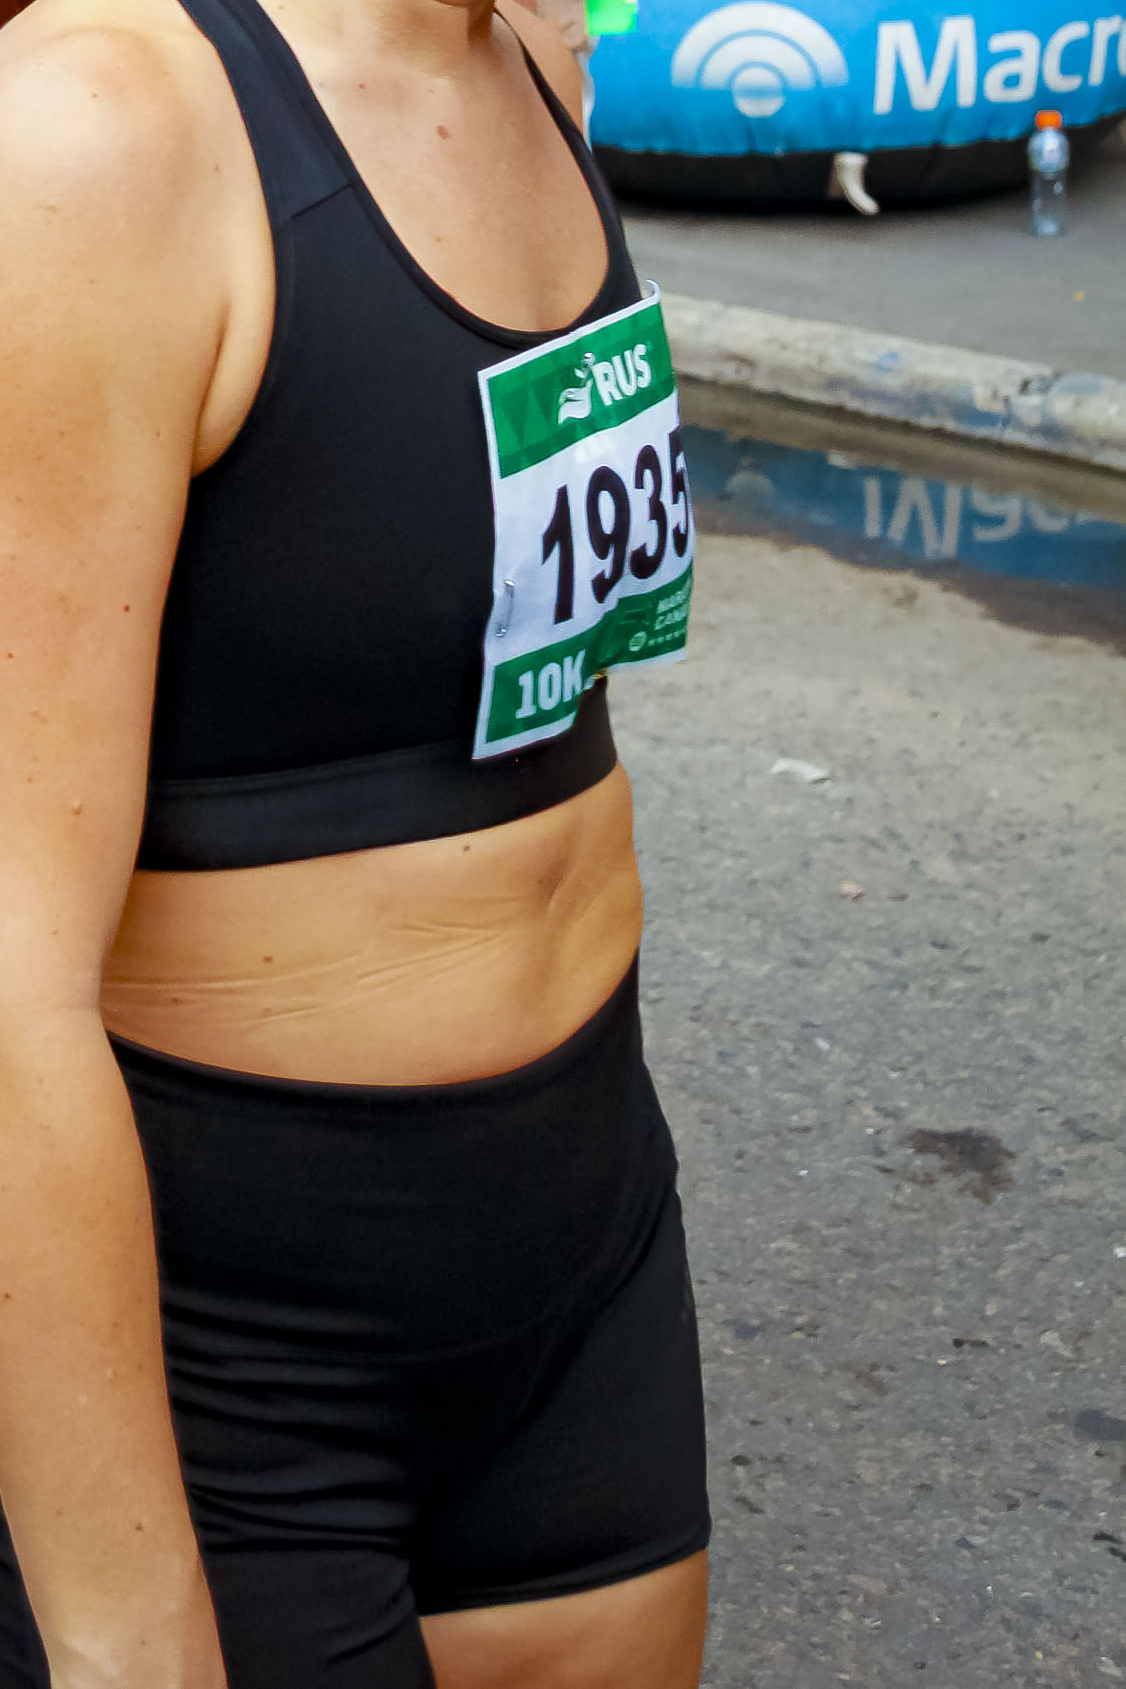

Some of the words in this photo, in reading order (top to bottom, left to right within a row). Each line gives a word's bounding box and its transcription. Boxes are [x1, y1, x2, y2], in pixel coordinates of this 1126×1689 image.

[873, 15, 1126, 116] Macr
[593, 343, 653, 407] RUS
[541, 431, 689, 625] 1935
[515, 649, 586, 719] 10K
